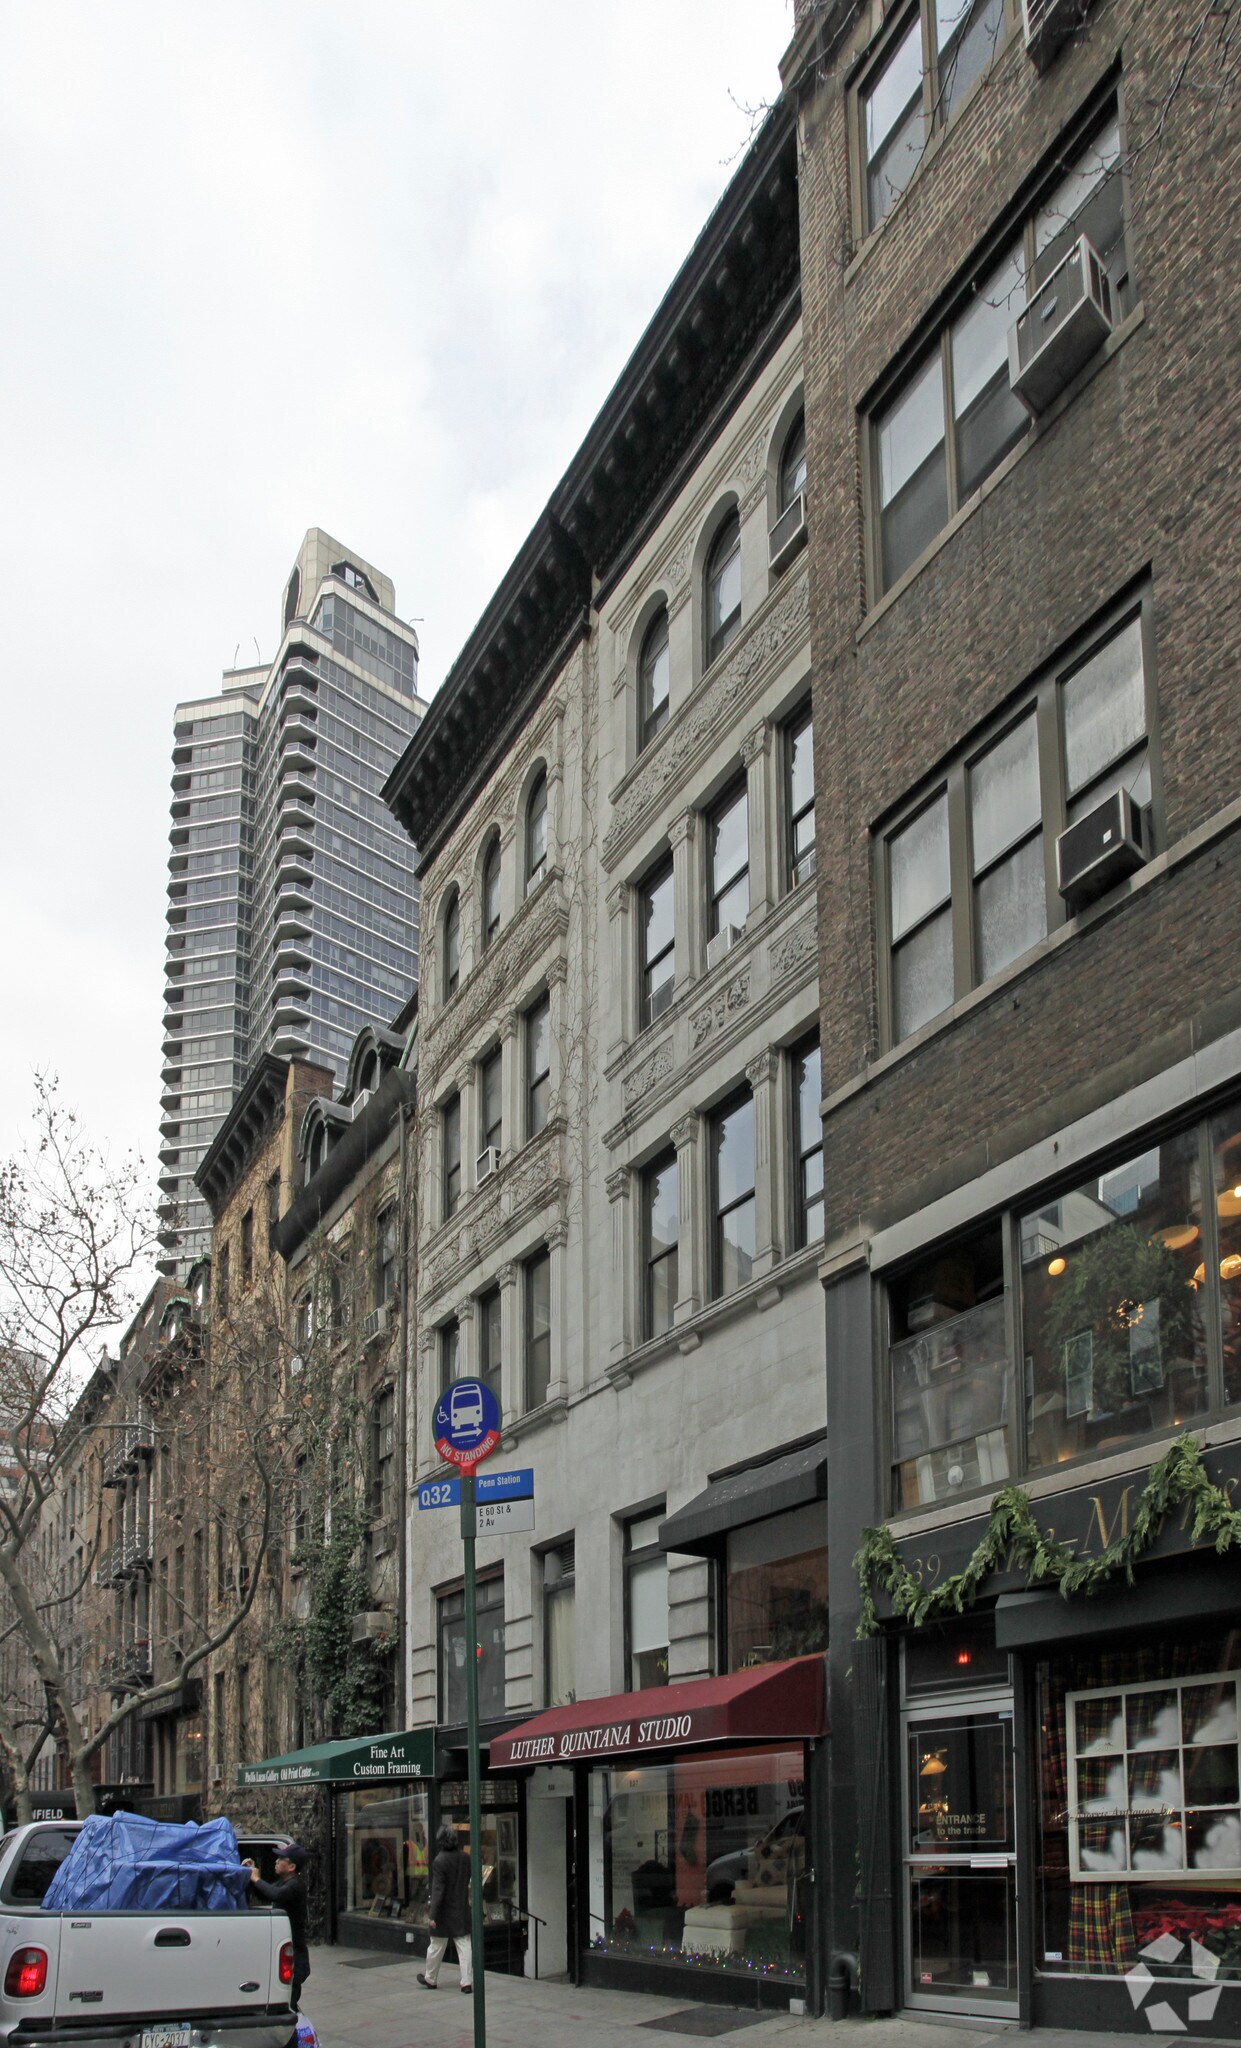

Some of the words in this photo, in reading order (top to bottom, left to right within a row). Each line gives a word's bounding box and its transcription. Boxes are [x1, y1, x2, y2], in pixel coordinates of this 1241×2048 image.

[440, 1443, 453, 1457] NO
[453, 1436, 495, 1462] STANDING
[478, 1479, 496, 1489] Penn
[497, 1474, 521, 1486] Station
[421, 1484, 451, 1506] Q32
[479, 1508, 484, 1517] E
[485, 1506, 495, 1516] 60
[496, 1505, 504, 1515] St
[506, 1504, 512, 1514] &
[479, 1518, 484, 1528] 2
[486, 1518, 495, 1527] Av
[510, 1736, 555, 1760] LUTHER
[558, 1724, 632, 1758] QUINTANA
[637, 1714, 692, 1743] STUDIO
[370, 1745, 388, 1759] Fine
[389, 1745, 405, 1758] Art
[280, 1768, 288, 1781] Old
[288, 1767, 298, 1780] Print
[353, 1762, 386, 1776] Custom
[387, 1760, 422, 1776] Framing
[936, 1813, 986, 1825] ENTRANCE
[947, 1826, 962, 1835] the
